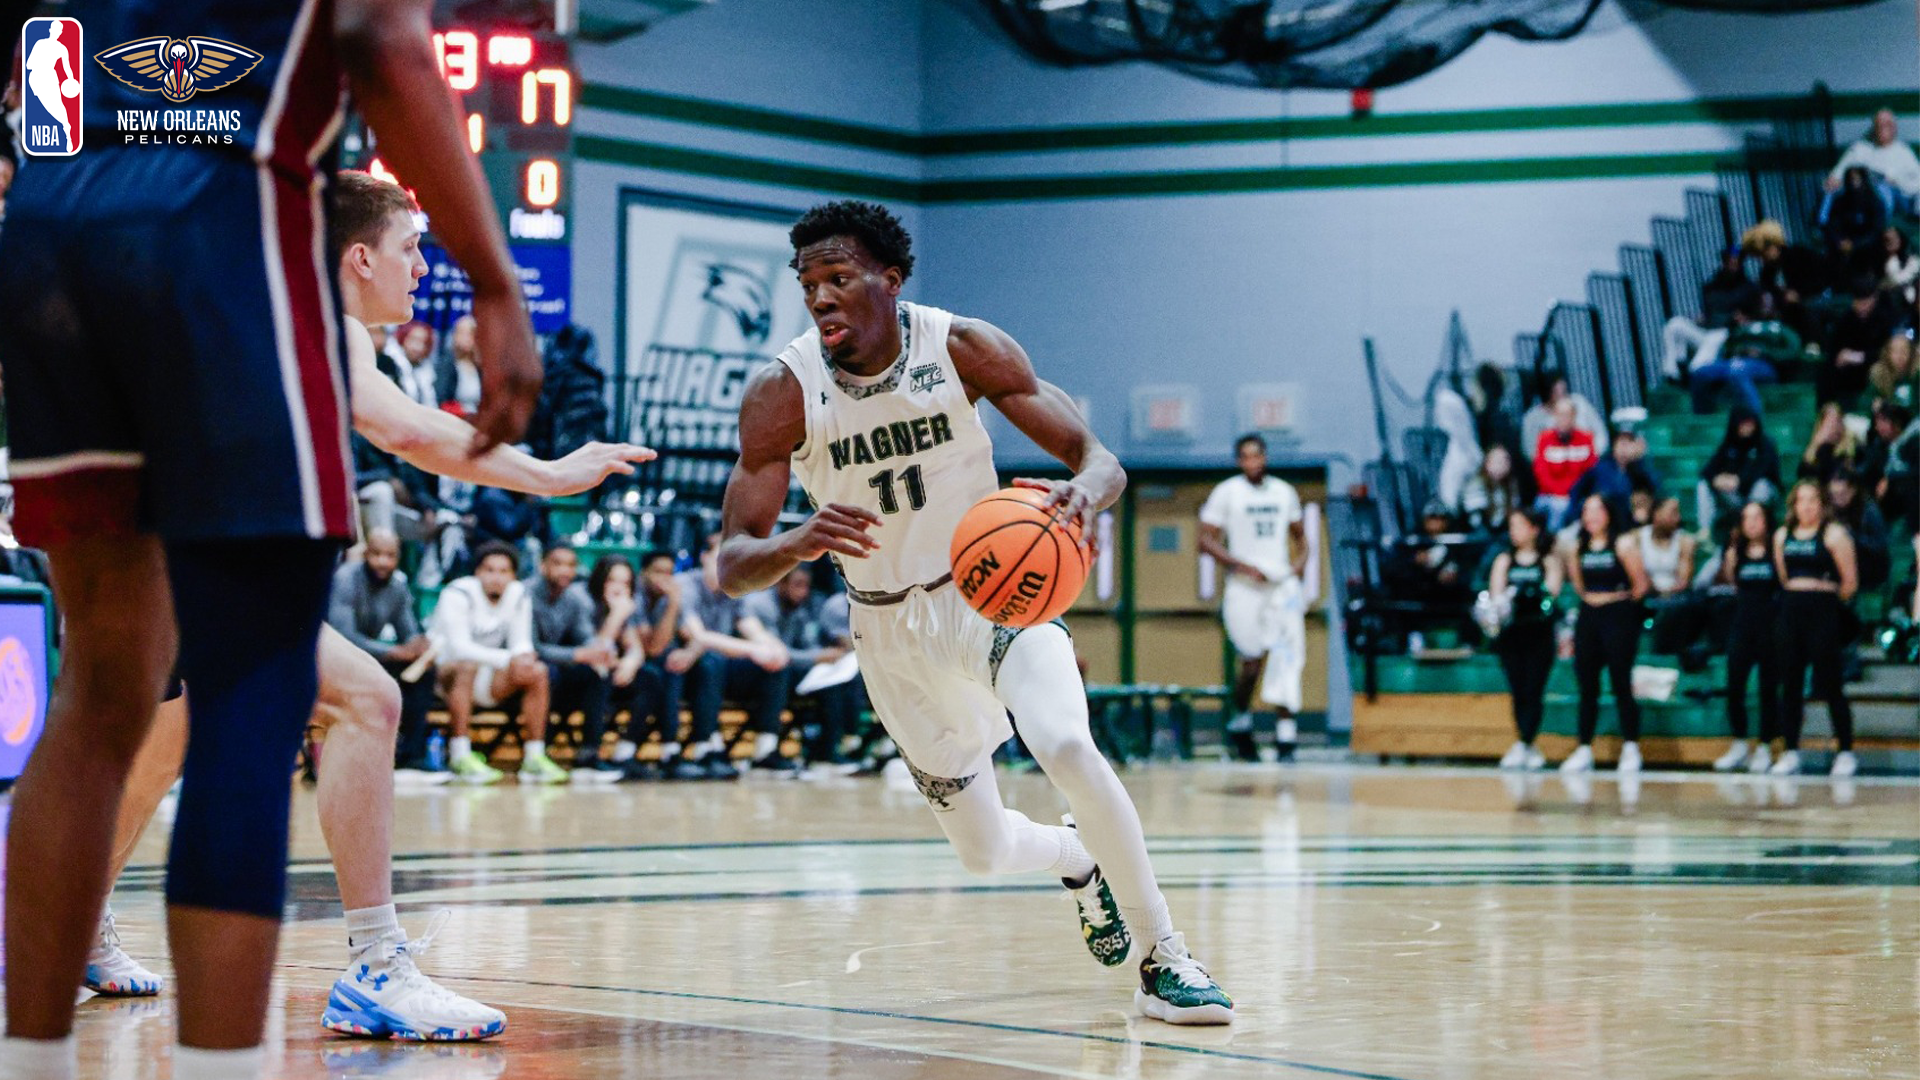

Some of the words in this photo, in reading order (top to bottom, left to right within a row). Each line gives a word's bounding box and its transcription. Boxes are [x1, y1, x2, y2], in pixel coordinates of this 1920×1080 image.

[522, 69, 570, 125] 17
[528, 160, 558, 206] 0
[641, 346, 773, 412] WAG
[910, 367, 942, 392] NEC
[828, 412, 954, 471] WAGNER
[868, 464, 927, 515] 11
[992, 570, 1048, 623] Wilso
